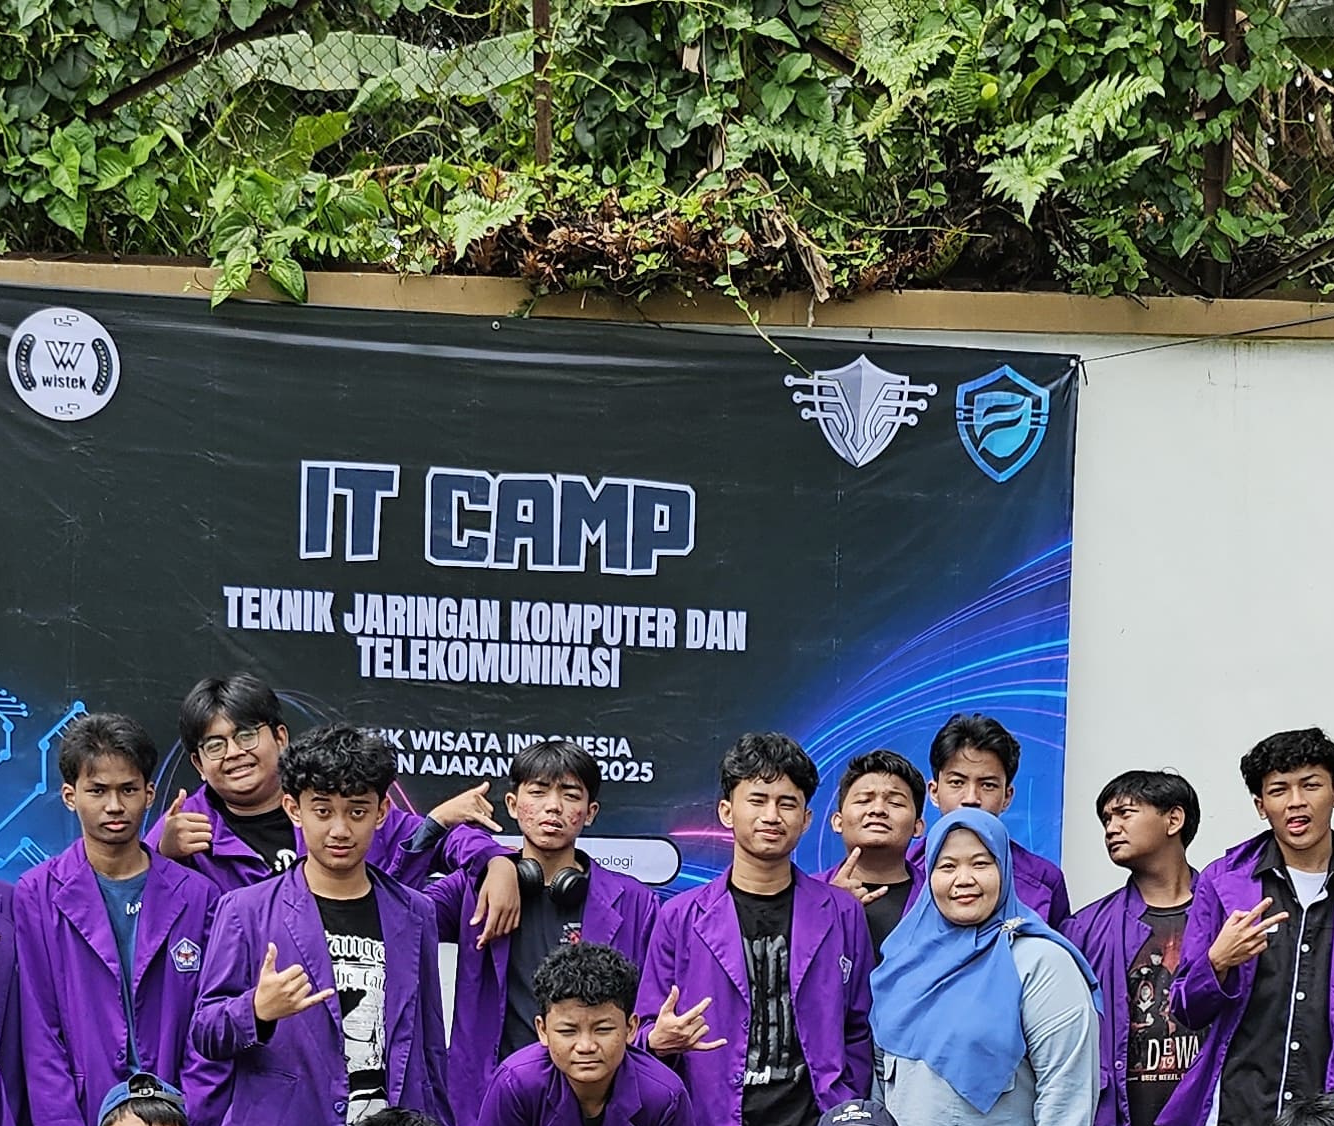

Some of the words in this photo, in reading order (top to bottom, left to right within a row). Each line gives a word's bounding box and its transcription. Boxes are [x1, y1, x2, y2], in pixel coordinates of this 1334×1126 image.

[42, 374, 87, 390] wistek
[299, 460, 400, 561] IT
[425, 466, 696, 576] CAMP
[223, 586, 335, 632] TEKNIK
[343, 592, 500, 640] JARINGAN
[510, 600, 676, 648] KOMPUTER
[685, 608, 747, 651] DAN
[356, 636, 620, 688] TELEKOMUNIKASI
[410, 730, 502, 753] WISATA
[420, 754, 514, 777] AJARAN
